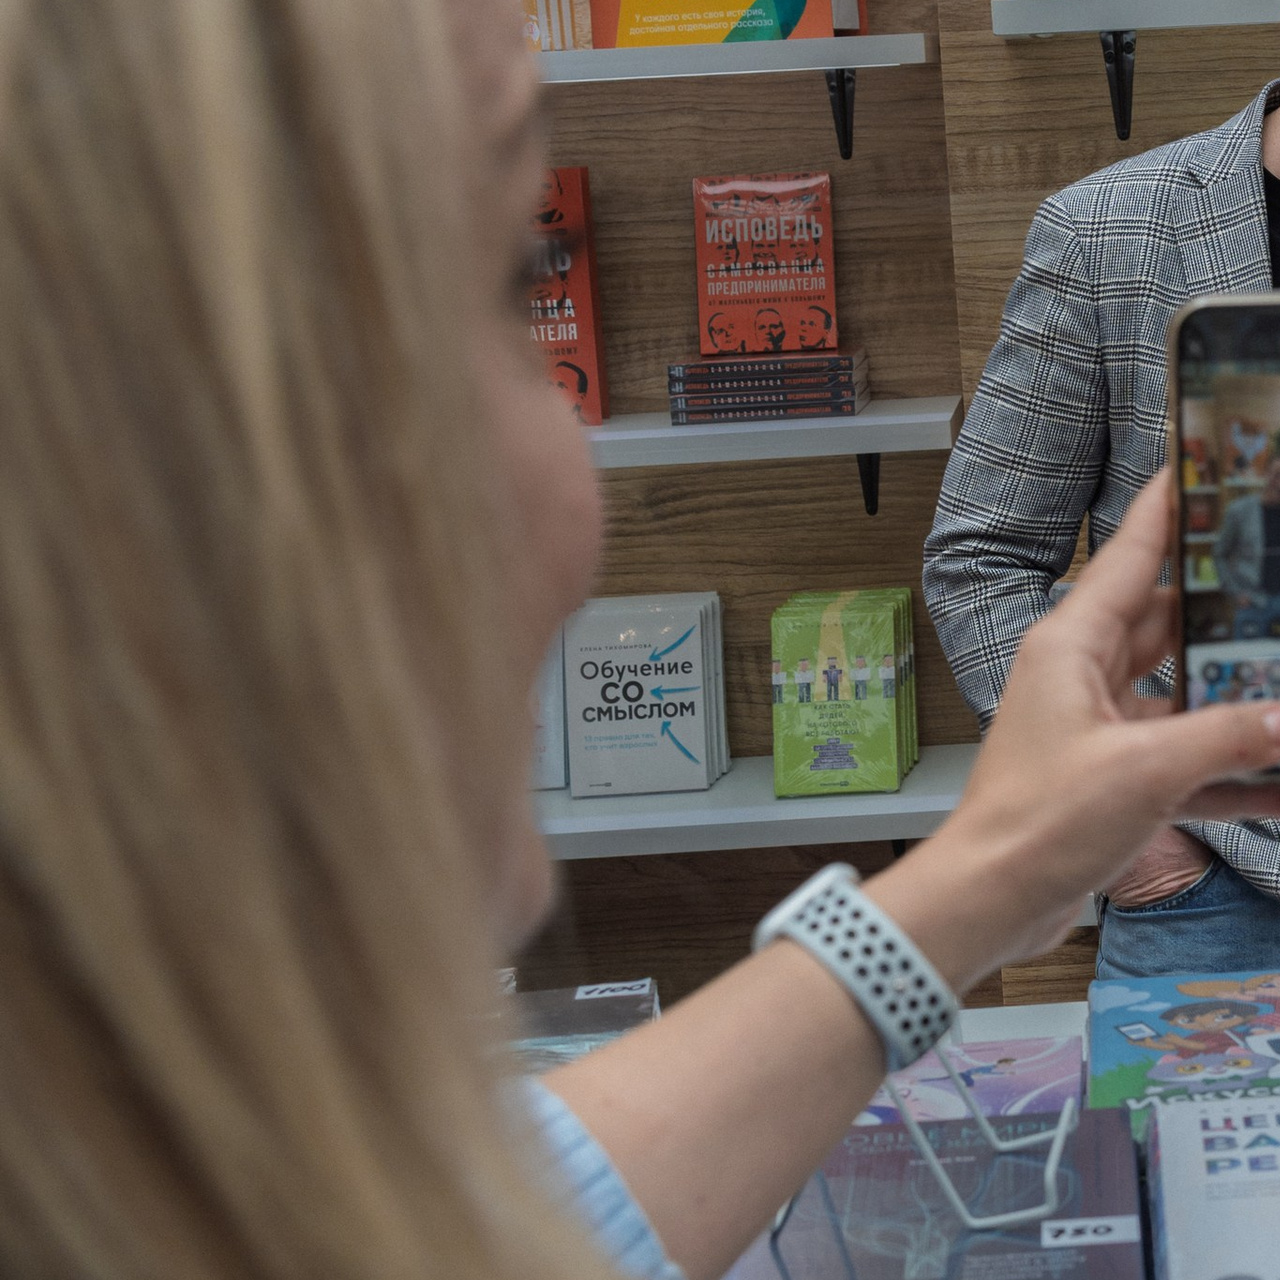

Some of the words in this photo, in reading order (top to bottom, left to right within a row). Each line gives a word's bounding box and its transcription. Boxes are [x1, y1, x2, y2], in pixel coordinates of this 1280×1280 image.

[682, 12, 701, 20] есть
[726, 8, 766, 18] история,
[730, 18, 774, 28] рассказа
[705, 215, 824, 244] ИСПОВЕДЬ
[707, 258, 826, 280] САМОЗВАНЦА
[707, 277, 826, 296] ПРЕДПРИНИМАТЕЛЯ
[605, 643, 652, 651] ТИХОМИРОВА
[580, 659, 694, 682] Обучение
[582, 701, 696, 723] СМЫСЛОМ
